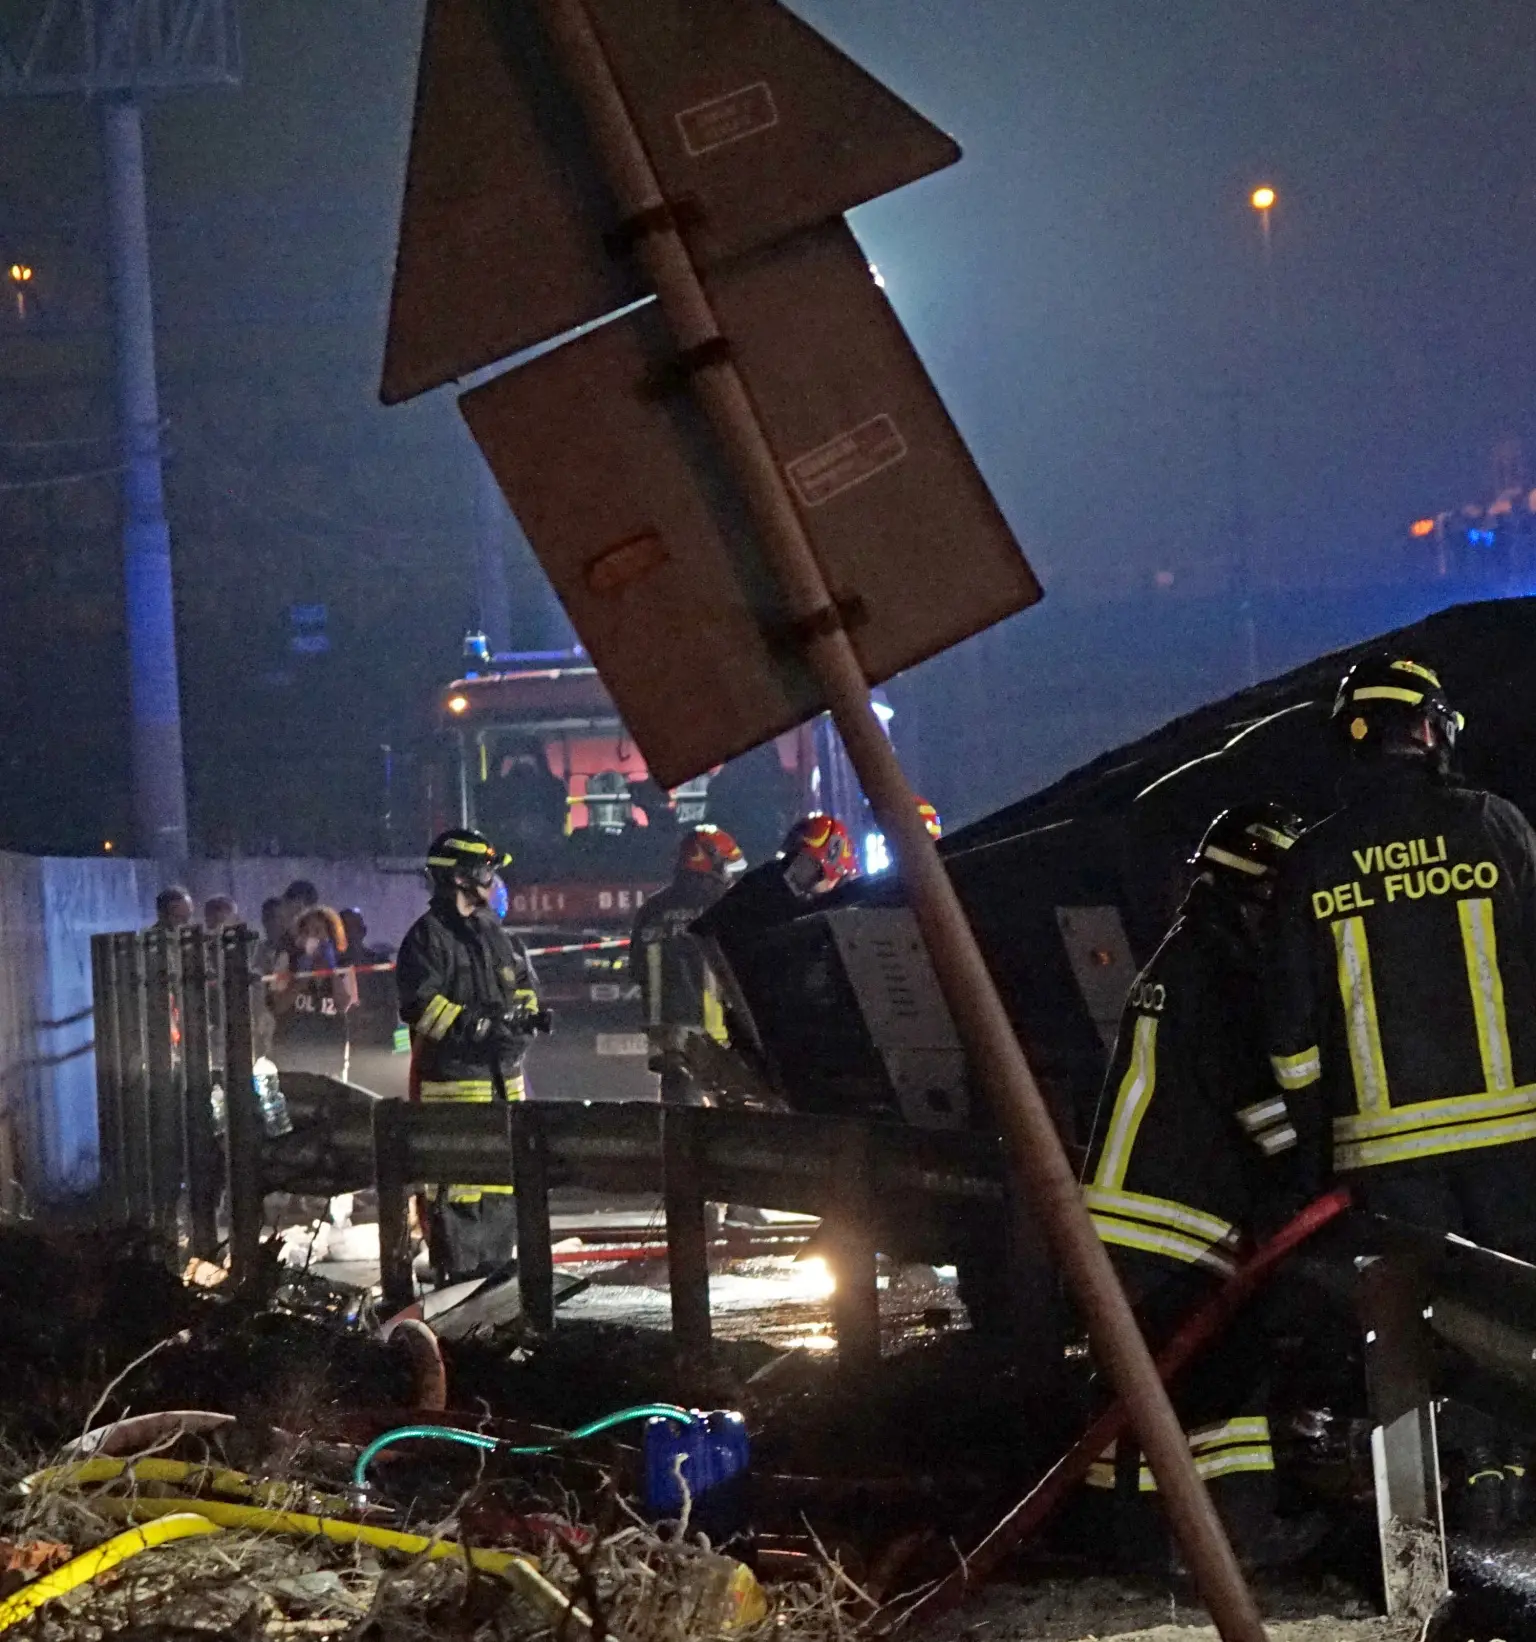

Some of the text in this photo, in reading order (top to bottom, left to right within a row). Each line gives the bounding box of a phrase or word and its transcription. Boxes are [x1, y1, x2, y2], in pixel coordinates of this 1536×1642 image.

[1352, 835, 1448, 874] VIGILI
[513, 891, 565, 912] GILI
[1312, 861, 1498, 919] DEL FUOCO
[295, 994, 337, 1015] OL 12
